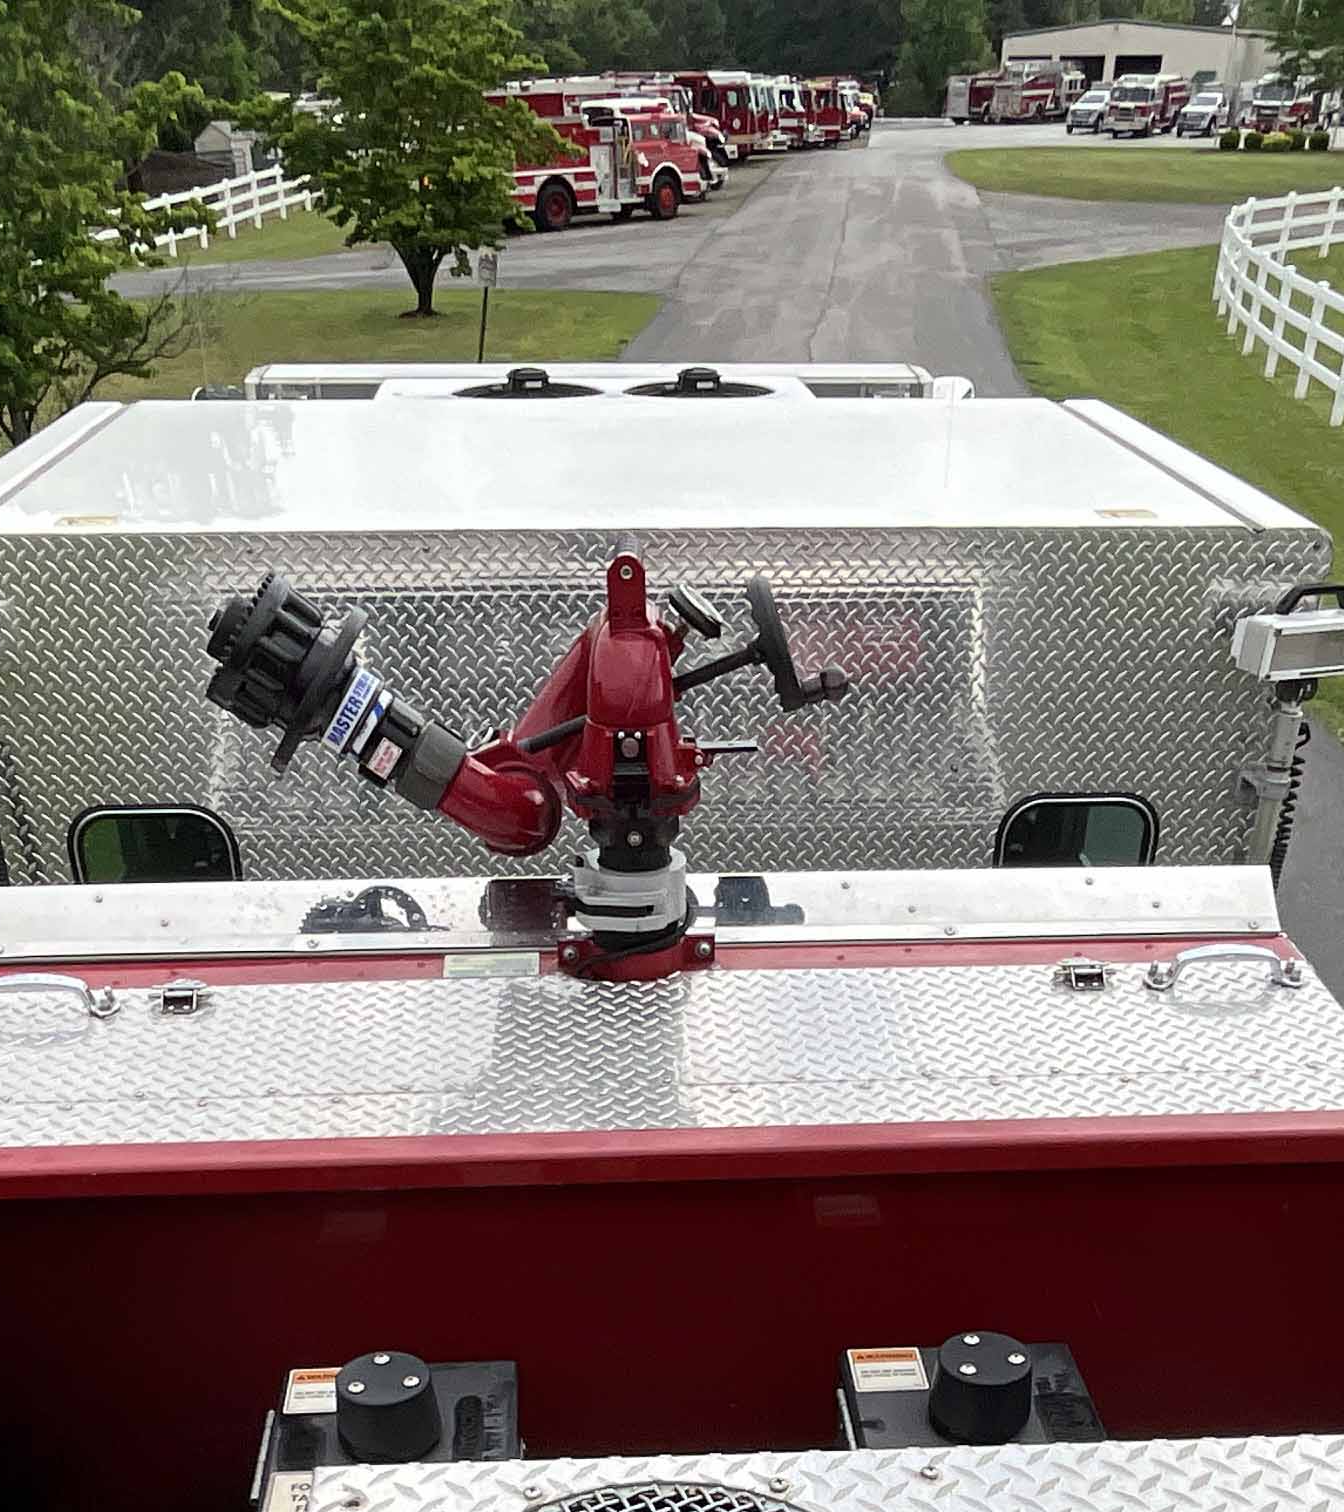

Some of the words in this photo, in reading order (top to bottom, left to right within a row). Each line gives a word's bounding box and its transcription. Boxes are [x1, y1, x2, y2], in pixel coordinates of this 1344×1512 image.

[327, 696, 364, 747] MASTER
[290, 1482, 312, 1492] FO
[290, 1494, 309, 1502] TA
